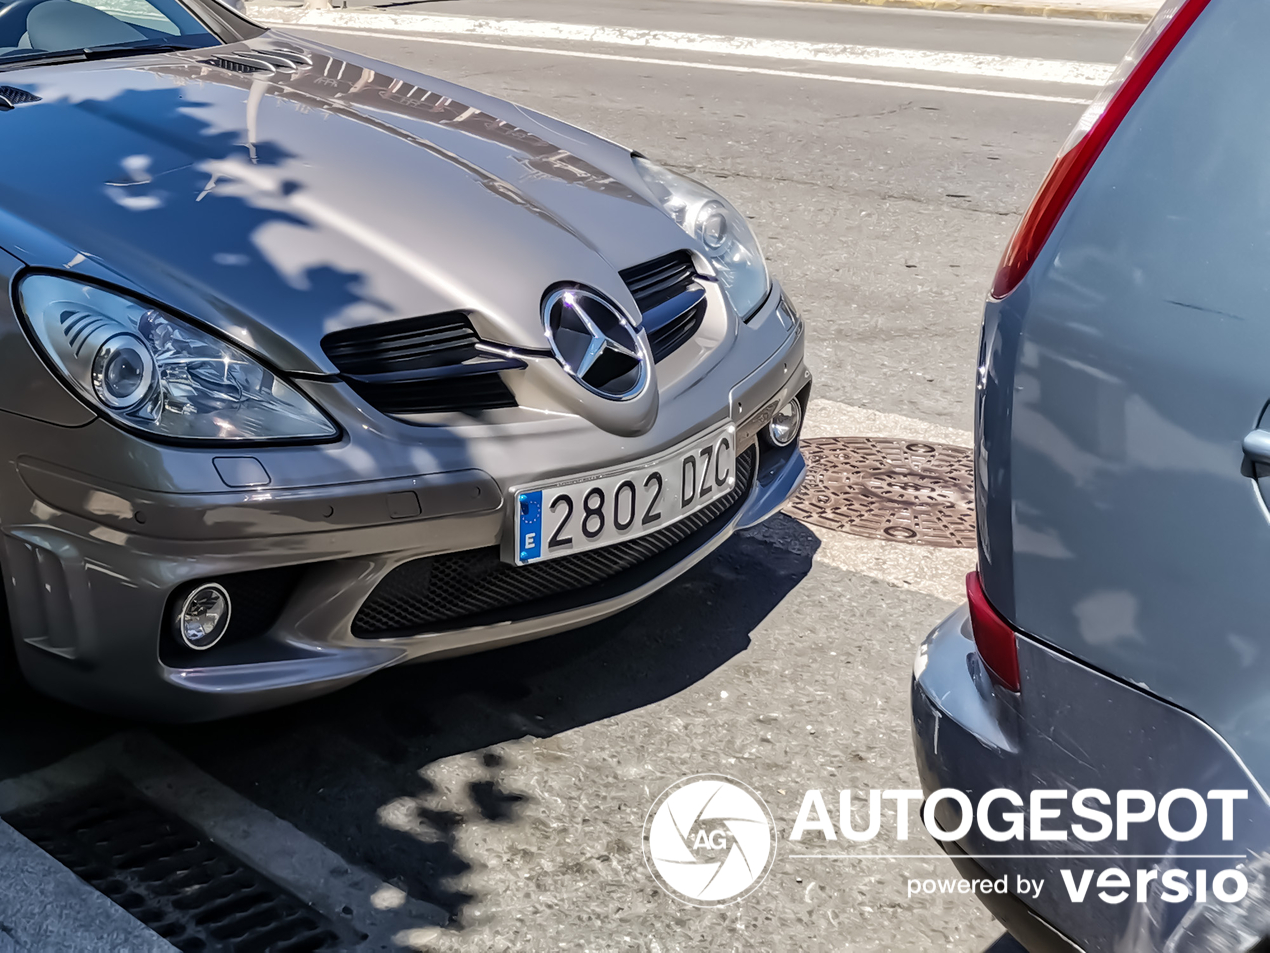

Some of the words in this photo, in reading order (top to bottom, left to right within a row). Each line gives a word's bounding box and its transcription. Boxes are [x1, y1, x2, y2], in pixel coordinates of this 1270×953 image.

[547, 471, 664, 549] 2802
[681, 437, 730, 509] DZC
[524, 533, 536, 549] E
